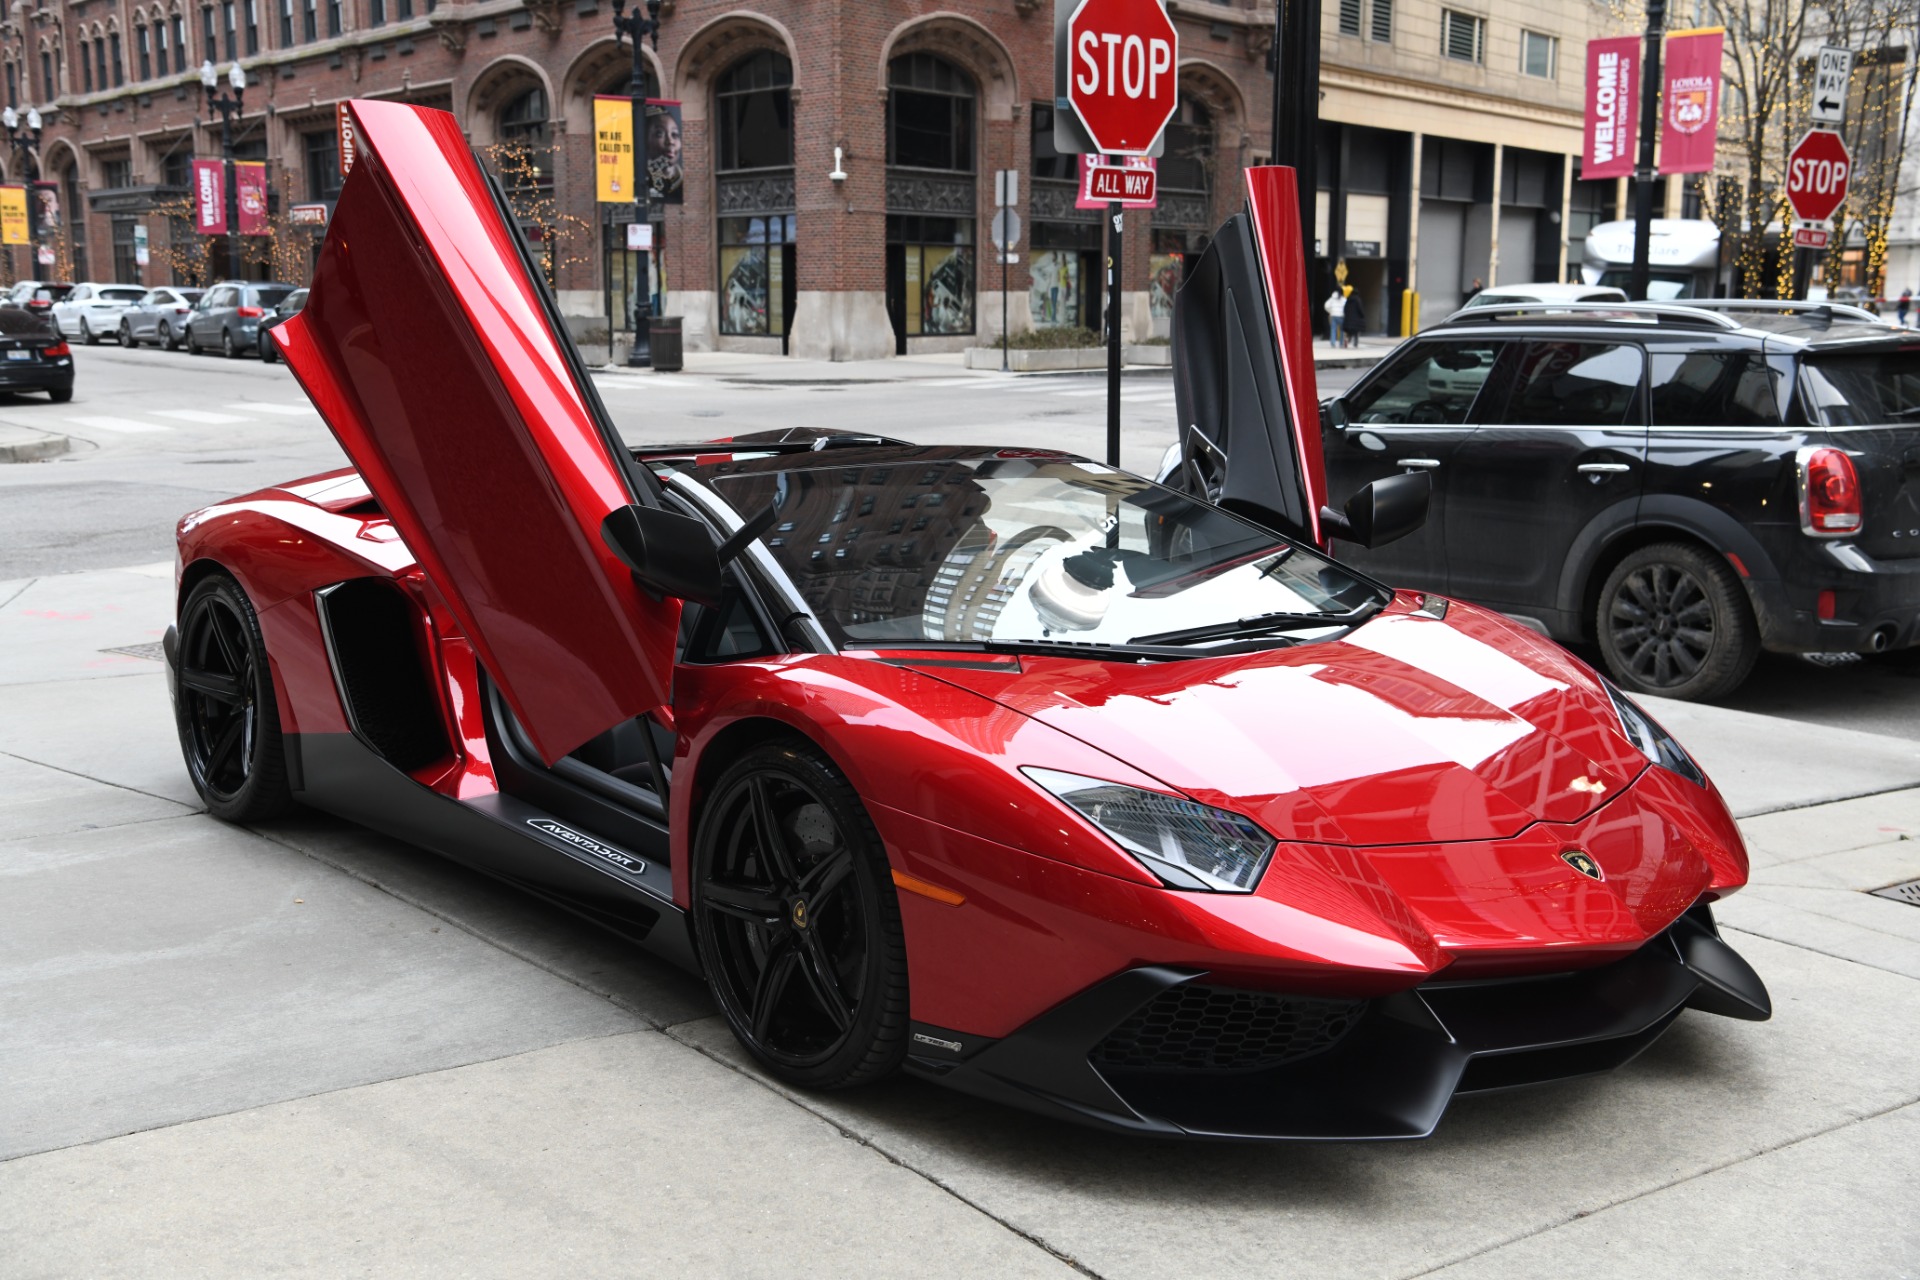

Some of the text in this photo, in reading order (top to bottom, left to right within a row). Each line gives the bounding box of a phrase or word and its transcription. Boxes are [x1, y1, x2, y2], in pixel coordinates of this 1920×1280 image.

[1077, 30, 1171, 99] STOP
[1822, 53, 1848, 73] ONE
[1671, 76, 1713, 89] LOYOLA
[1819, 75, 1845, 93] WAY
[1593, 52, 1618, 165] WELCOME
[1616, 58, 1630, 157] WATER TOWER CAMPUS
[599, 131, 621, 141] WE ARE
[599, 143, 631, 153] CALLED TO
[1096, 173, 1120, 194] ALL
[1125, 175, 1149, 195] WAY
[1790, 158, 1847, 195] STOP
[199, 167, 214, 227] WELCOME
[1797, 230, 1810, 243] ALL
[542, 824, 633, 866] AVENTADOR
